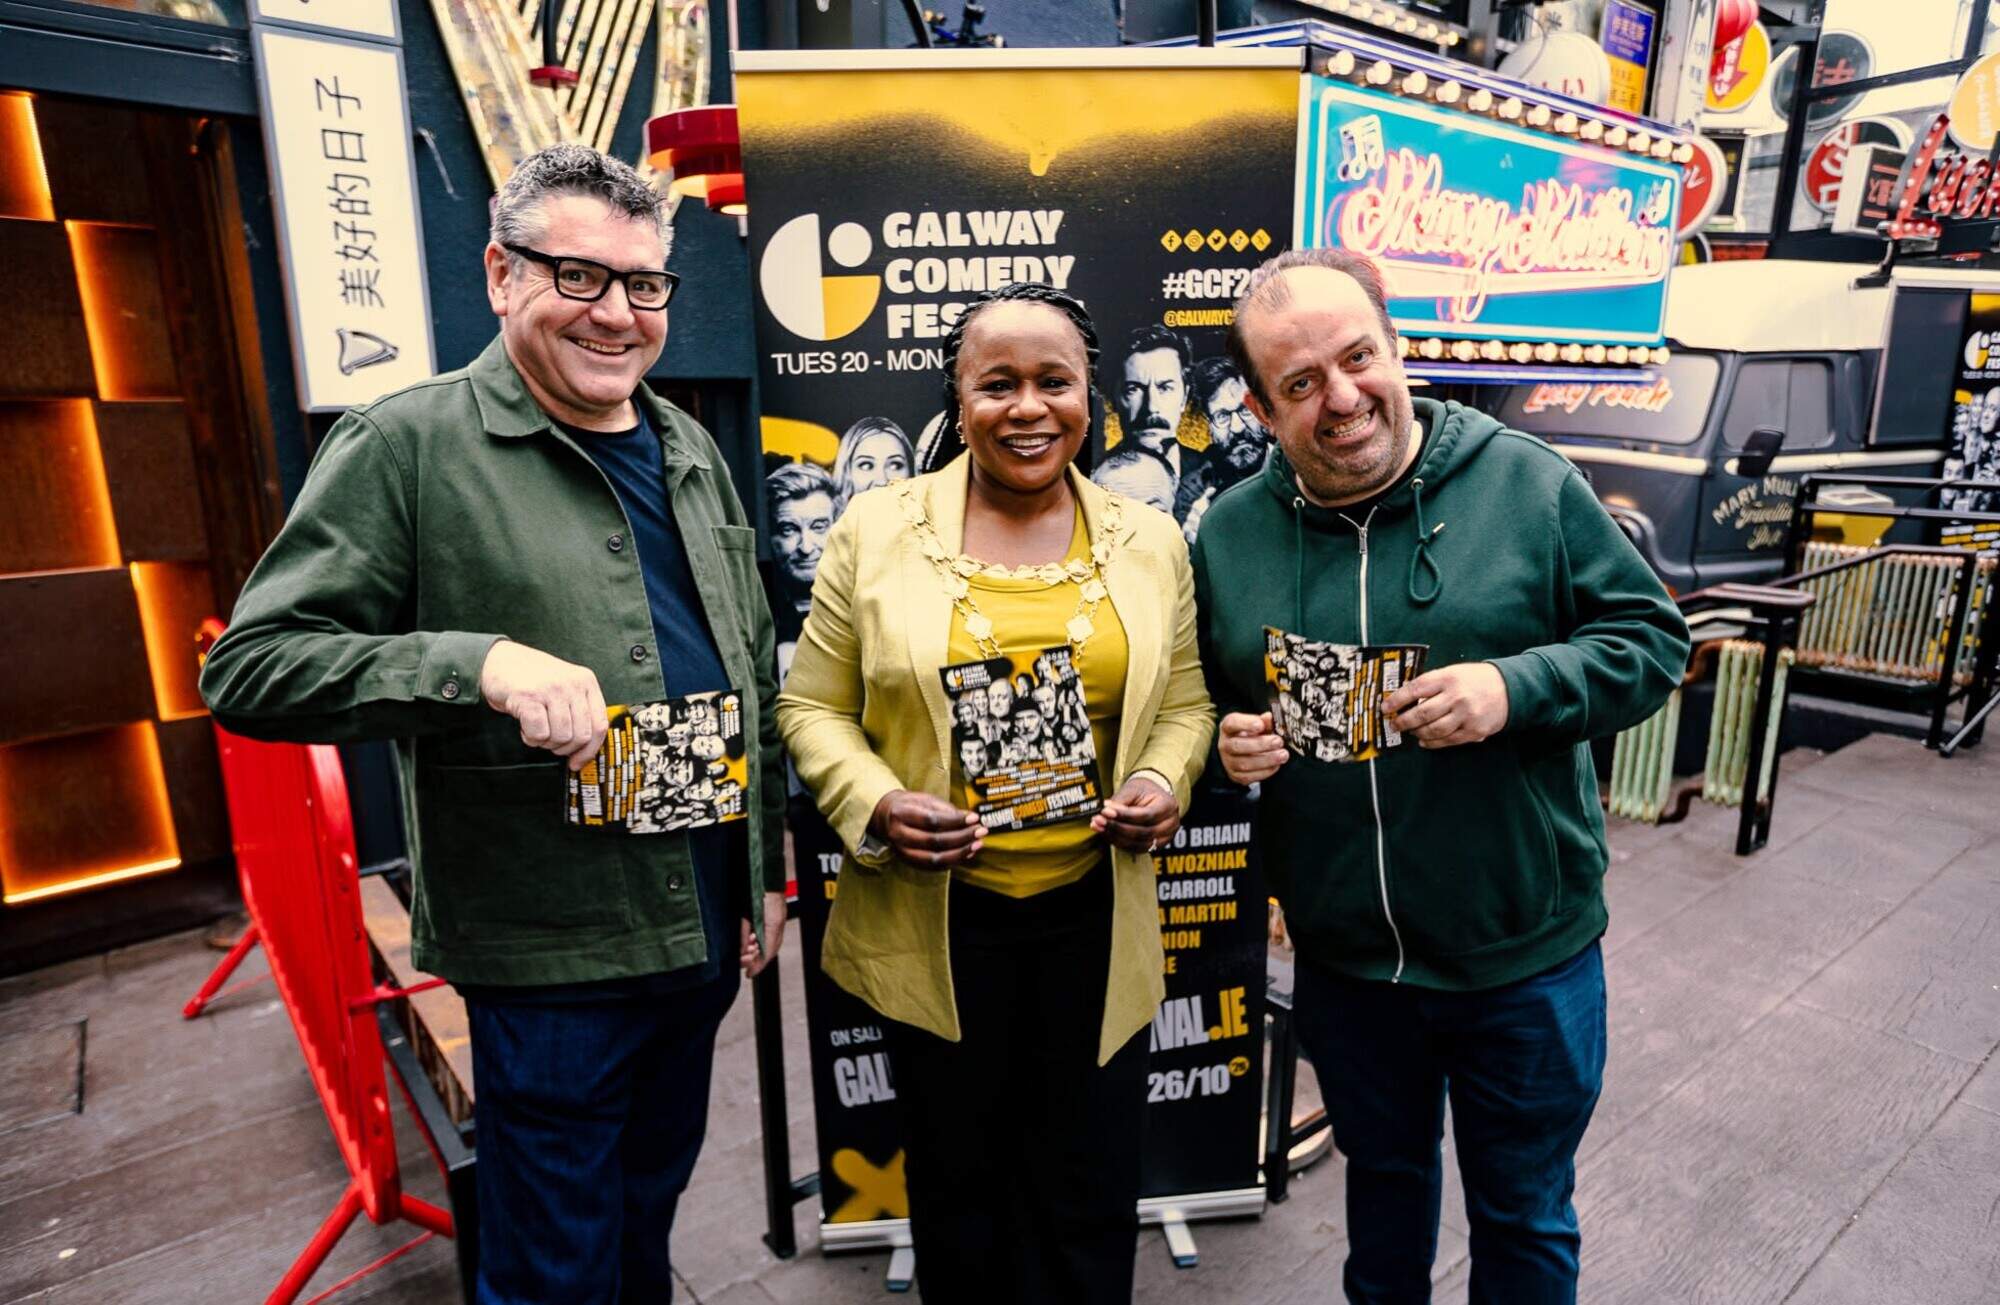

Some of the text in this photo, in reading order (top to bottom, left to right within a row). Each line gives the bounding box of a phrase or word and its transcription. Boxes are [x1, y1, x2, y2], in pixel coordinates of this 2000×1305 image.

[315, 75, 384, 308] 美好的日子
[882, 210, 1064, 249] GALWAY
[884, 255, 1076, 294] COMEDY
[886, 302, 968, 339] FES
[1164, 309, 1234, 327] @GALWAYC
[771, 351, 837, 375] TUES
[841, 351, 868, 373] 20
[886, 349, 943, 372] MON
[1712, 483, 1758, 525] MARY
[1190, 822, 1251, 847] BRIAIN
[817, 853, 843, 873] TO
[1153, 849, 1248, 875] E WOZNIAK
[824, 880, 838, 899] D
[1158, 876, 1235, 901] CARROLL
[1157, 901, 1237, 925] A MARTIN
[1161, 930, 1201, 950] NION
[830, 1029, 851, 1047] ON
[833, 1052, 896, 1108] GAL
[1147, 1064, 1230, 1104] 26/10
